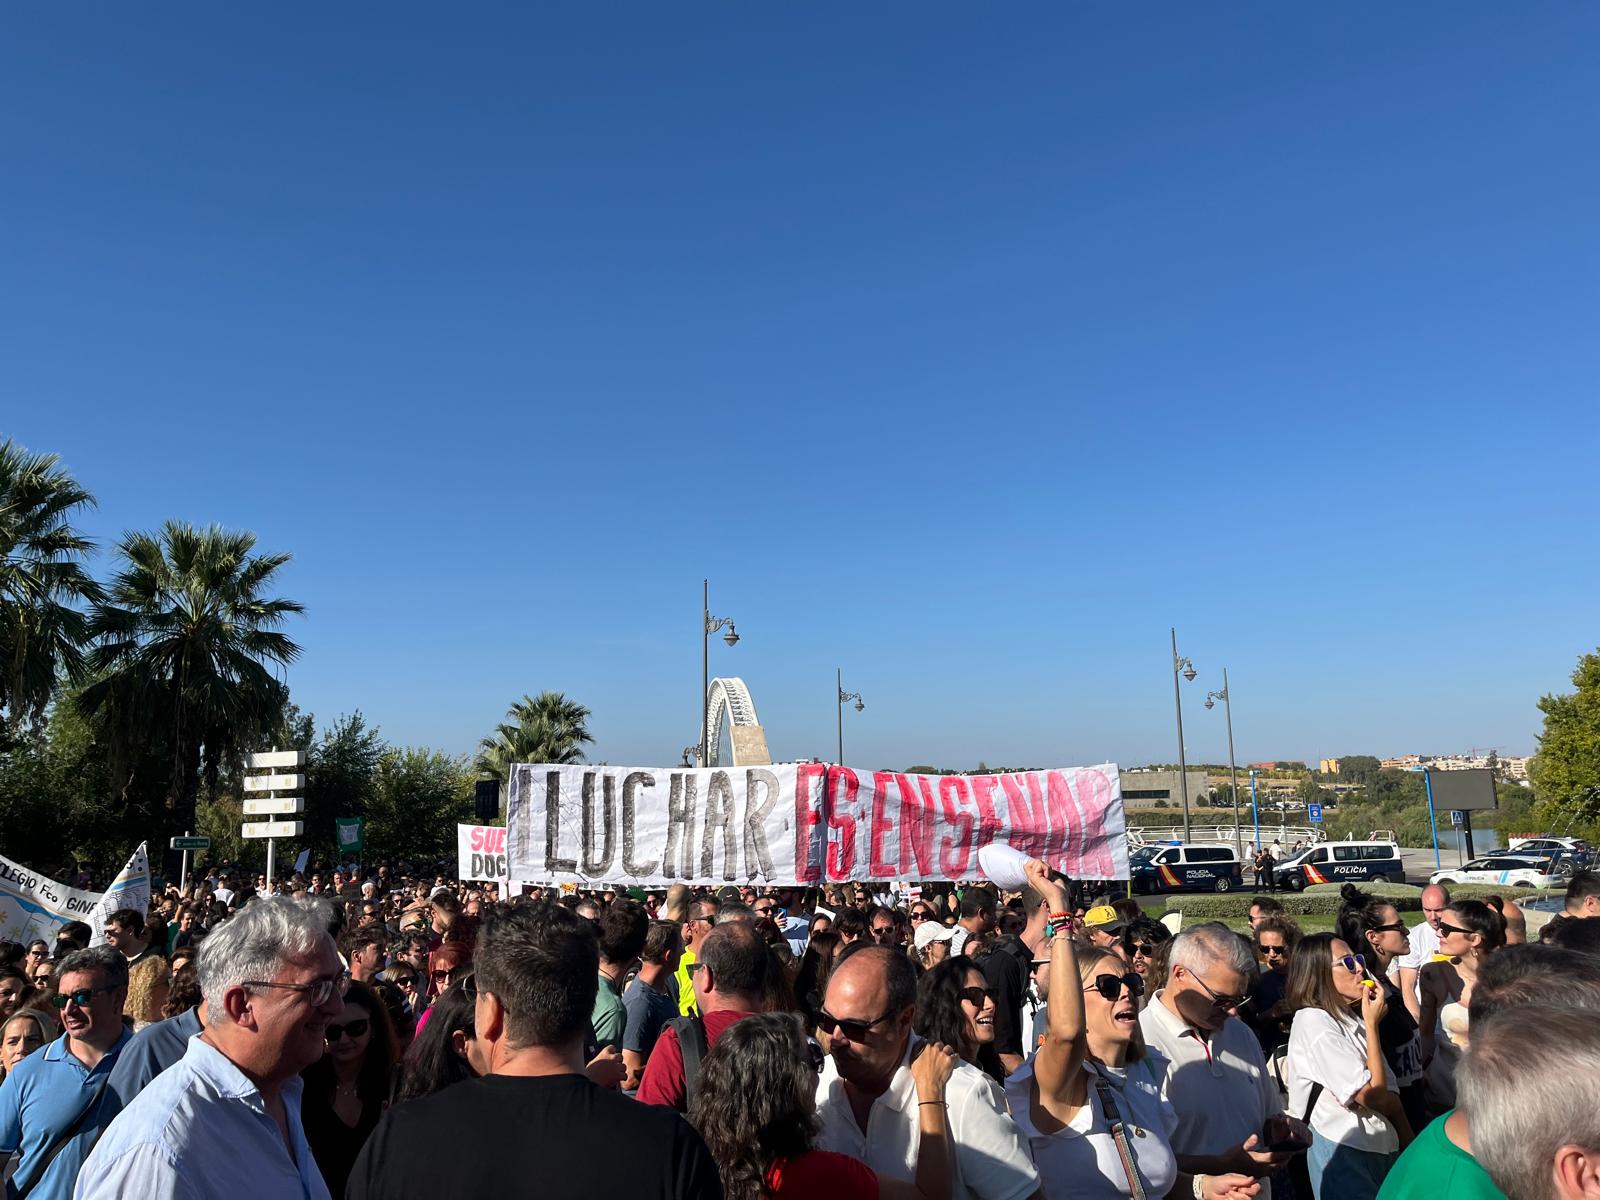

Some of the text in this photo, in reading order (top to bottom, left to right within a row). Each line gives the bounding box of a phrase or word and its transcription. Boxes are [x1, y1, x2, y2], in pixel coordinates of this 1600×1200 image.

[545, 769, 779, 882] LUCHAR
[794, 763, 859, 882] ES
[0, 862, 37, 889] OLEGIO
